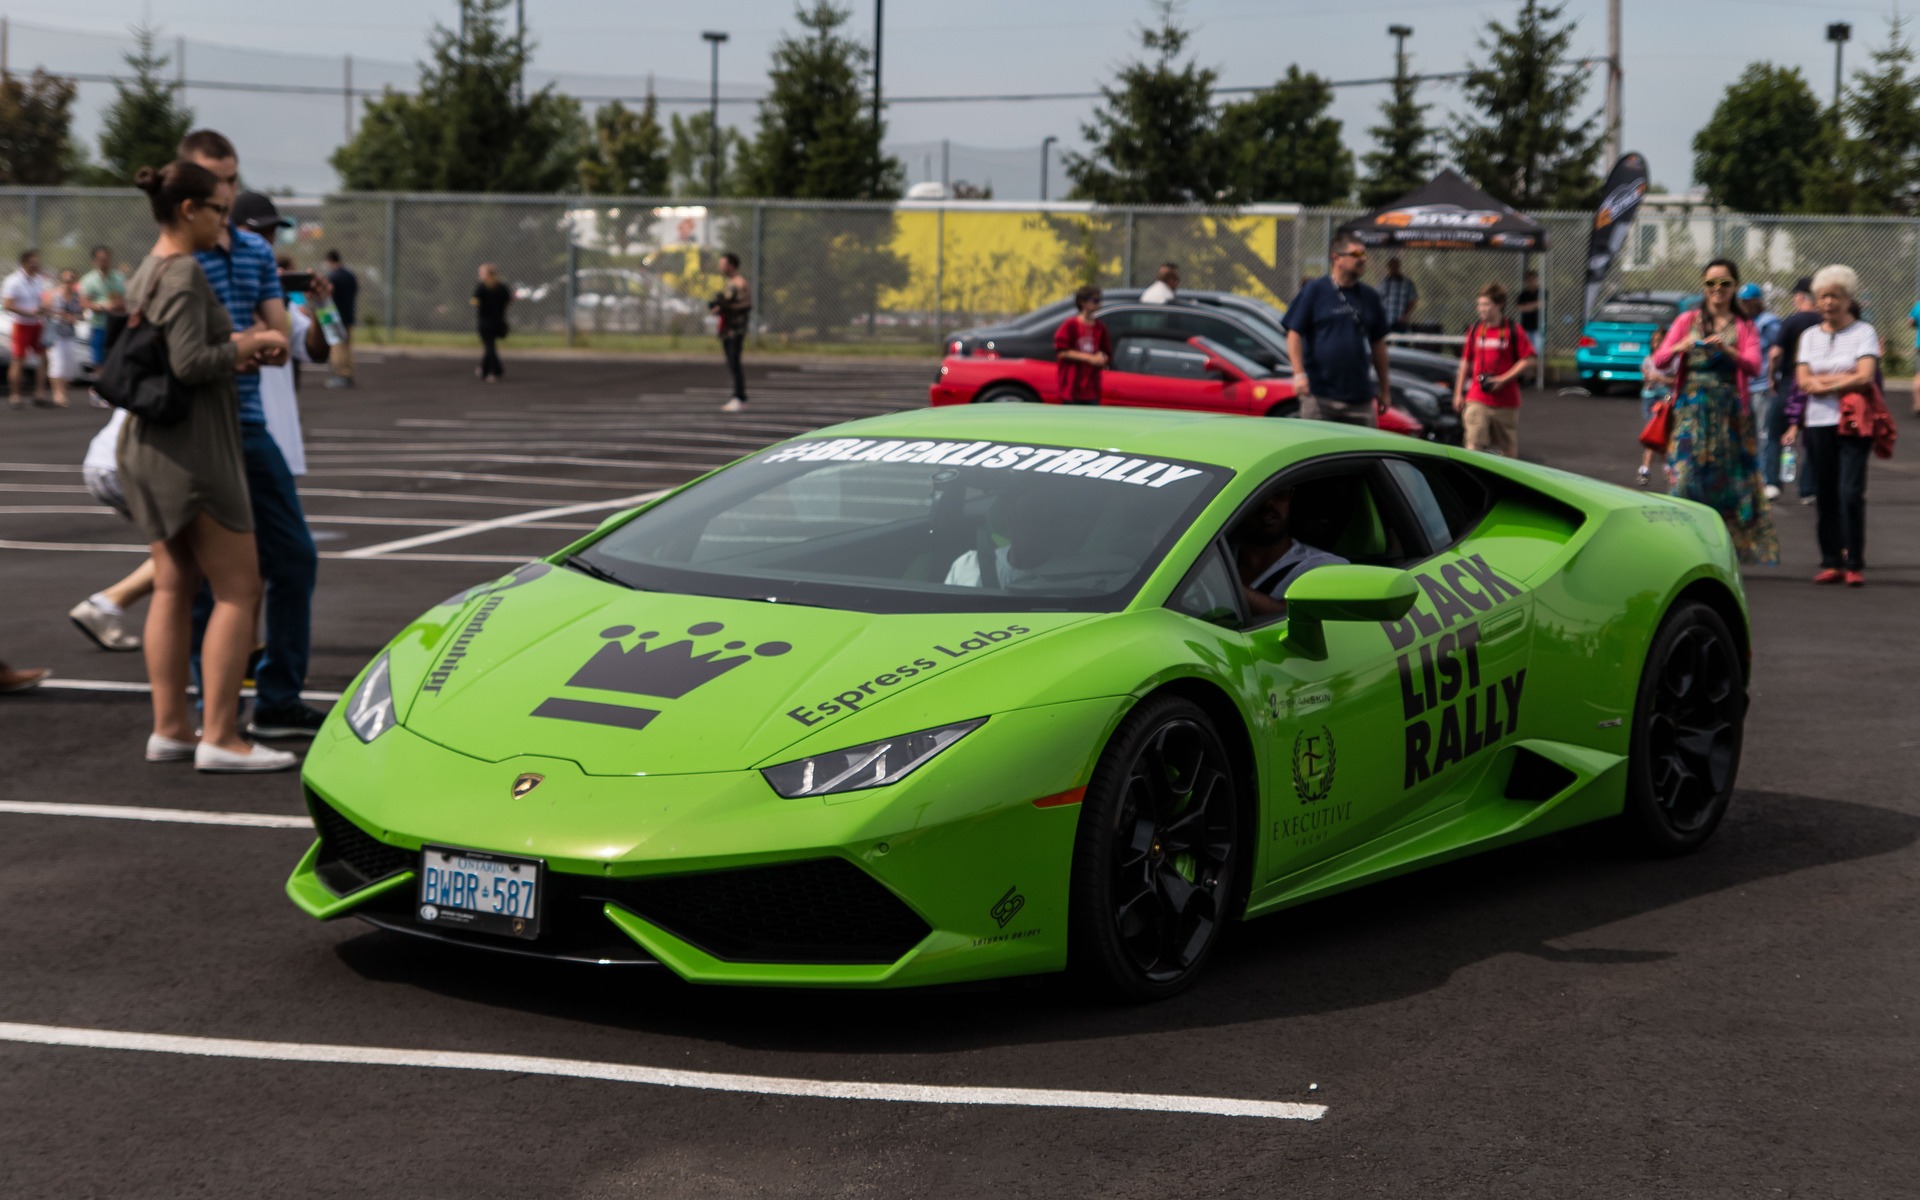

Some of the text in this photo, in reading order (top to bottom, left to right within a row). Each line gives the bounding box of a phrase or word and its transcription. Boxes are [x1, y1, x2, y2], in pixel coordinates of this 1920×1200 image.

[762, 438, 1203, 489] #BLACKLISTRALLY
[1380, 553, 1524, 650] BLACK
[786, 624, 1031, 727] Espress Labs
[1397, 621, 1481, 721] LIST
[1404, 668, 1527, 790] RALLY
[1273, 802, 1353, 842] EXECUTIVE
[425, 867, 535, 918] BWBR 587
[457, 858, 504, 874] ONTARIO
